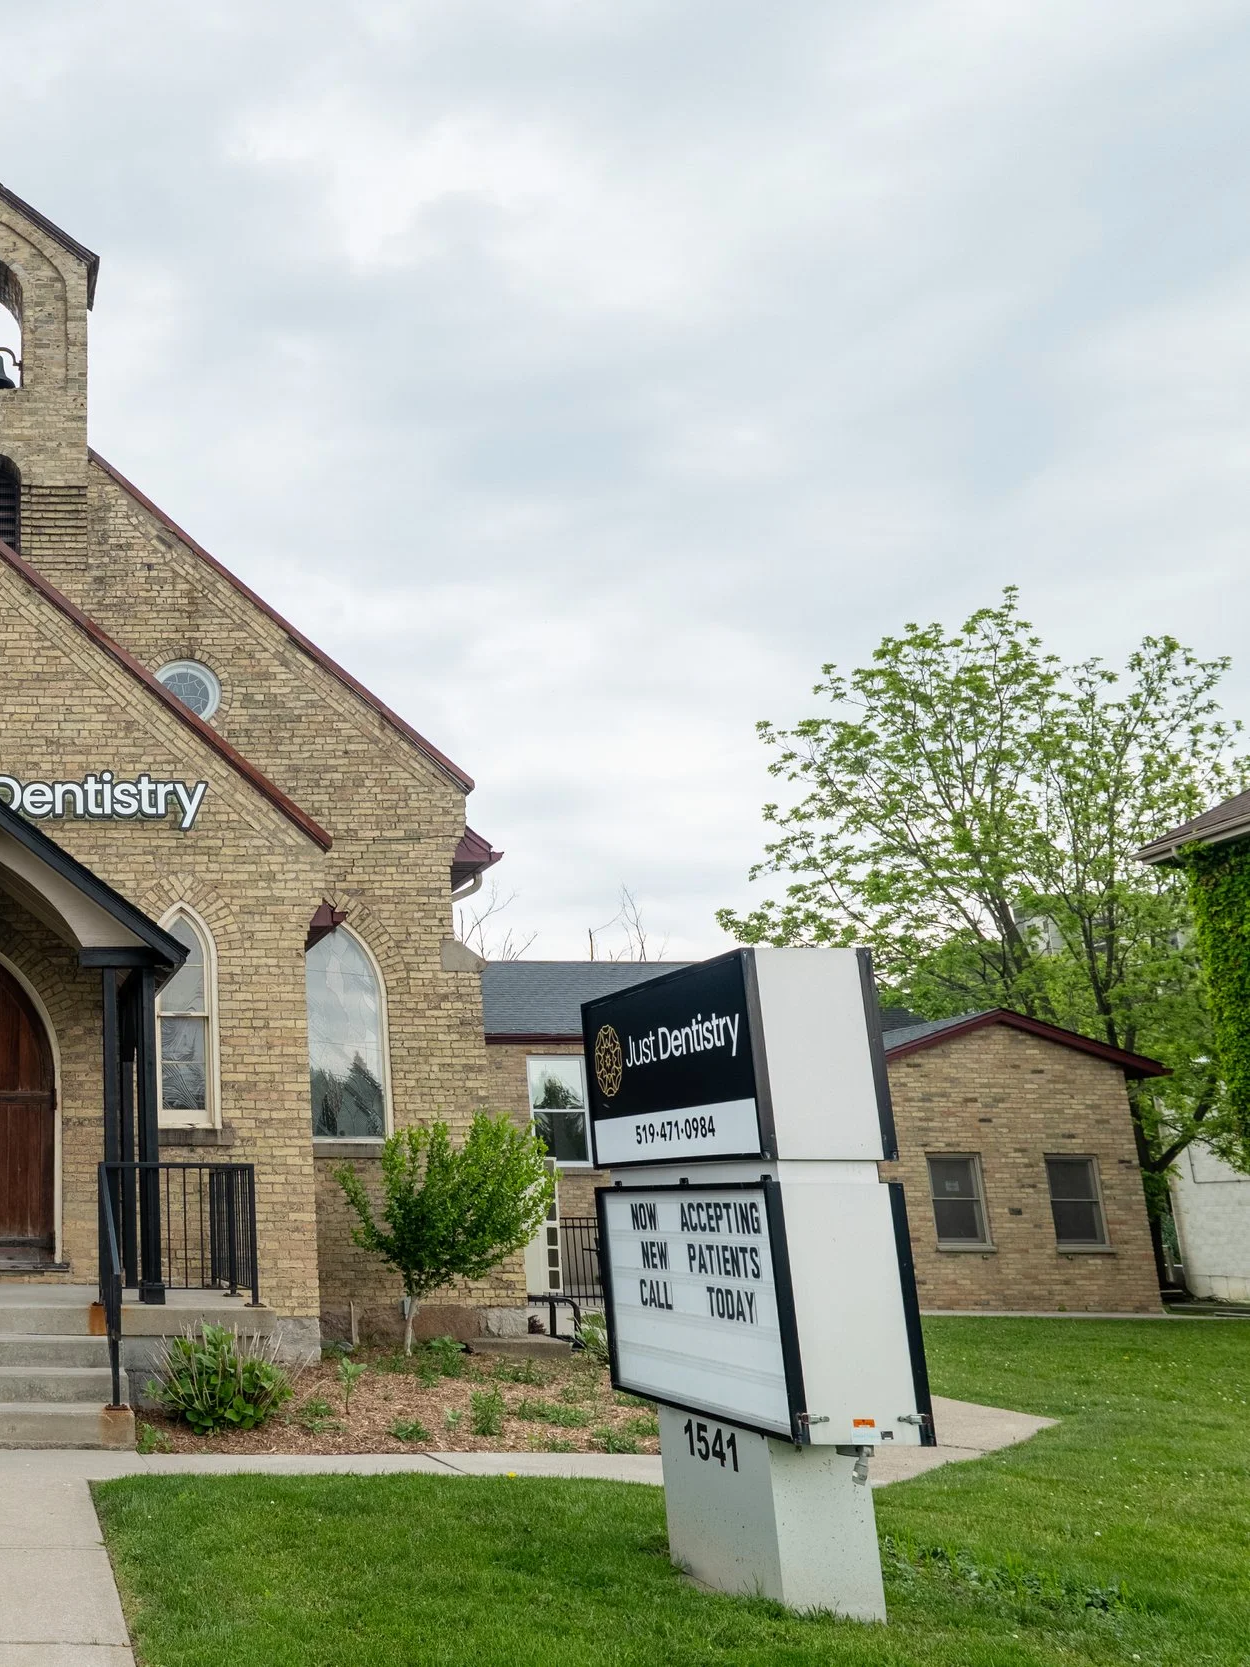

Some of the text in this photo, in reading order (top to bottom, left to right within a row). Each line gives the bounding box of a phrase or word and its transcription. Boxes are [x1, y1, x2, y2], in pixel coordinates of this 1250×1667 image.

[626, 1013, 739, 1067] Just Dentistry
[630, 1202, 761, 1234] NOW ACCEPTING
[641, 1241, 761, 1279] NEW PATIENTS
[640, 1279, 754, 1324] CALL TODAY
[684, 1418, 739, 1473] 1541
